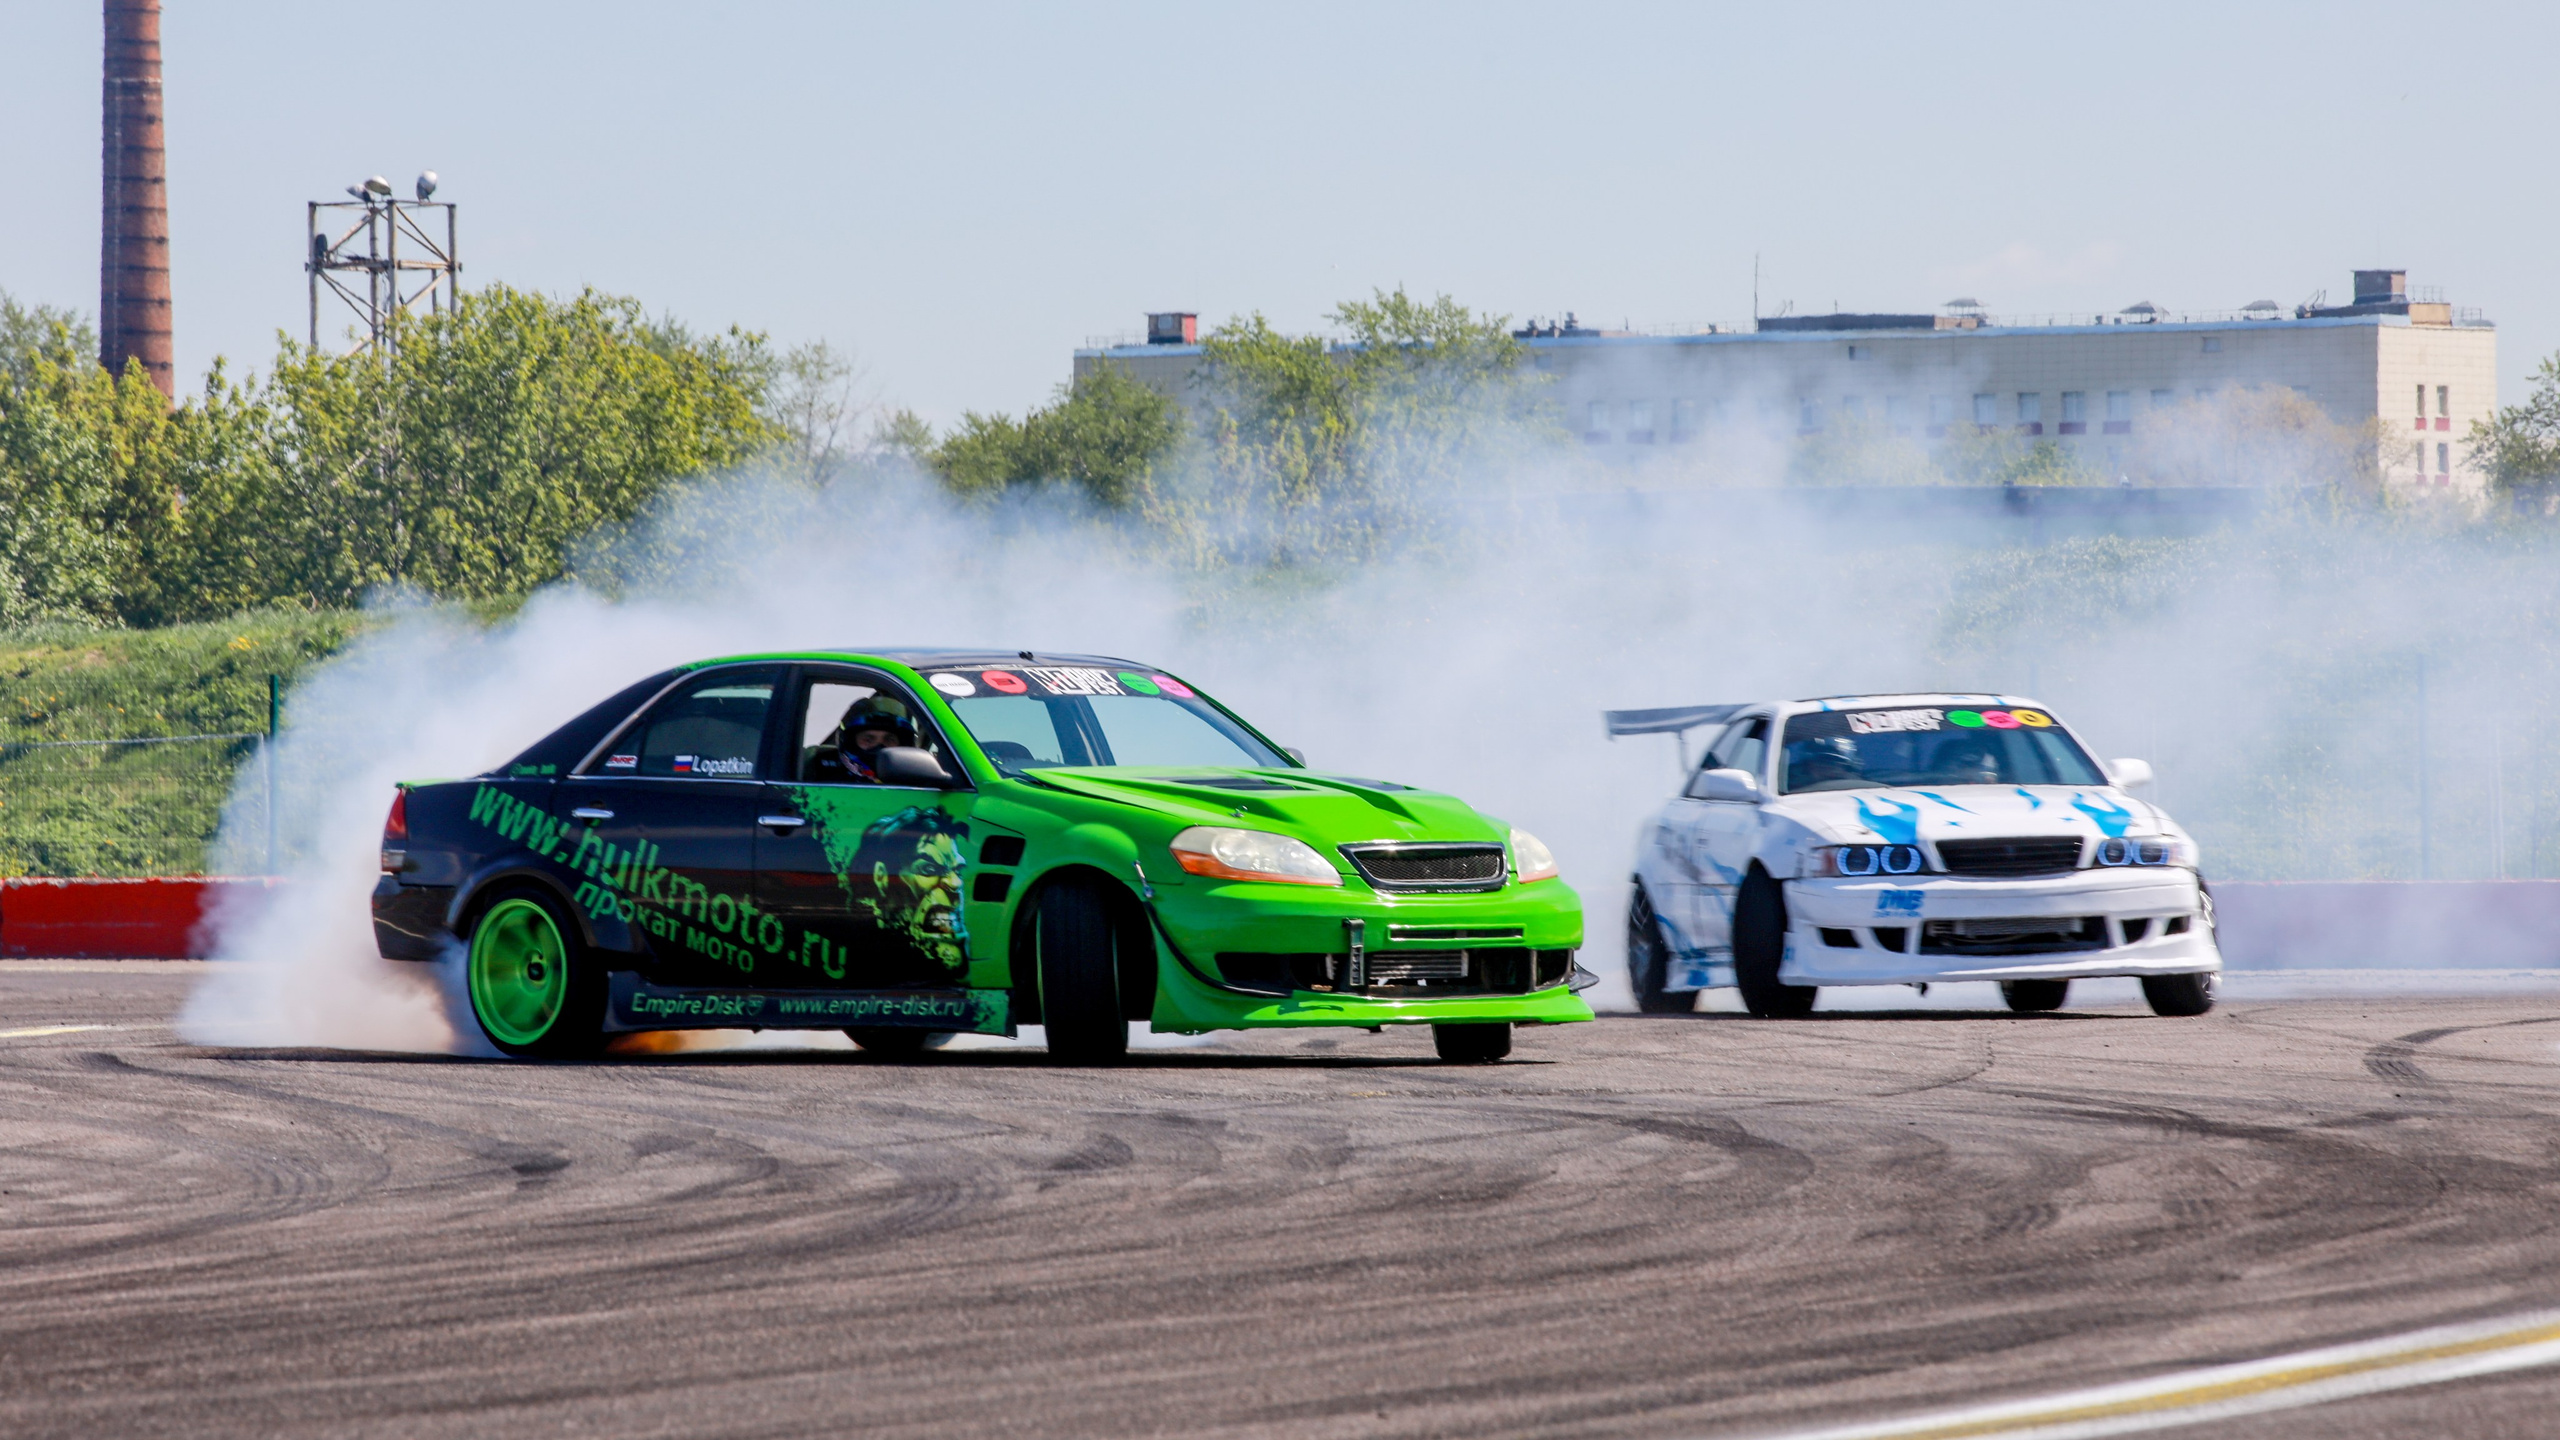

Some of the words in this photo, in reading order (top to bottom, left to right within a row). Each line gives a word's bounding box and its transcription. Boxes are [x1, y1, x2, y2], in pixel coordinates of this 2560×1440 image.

[691, 755, 754, 777] Lopatkin
[468, 782, 847, 980] www.hulkmoto.ru
[778, 994, 966, 1019] www.empire-disk.ru
